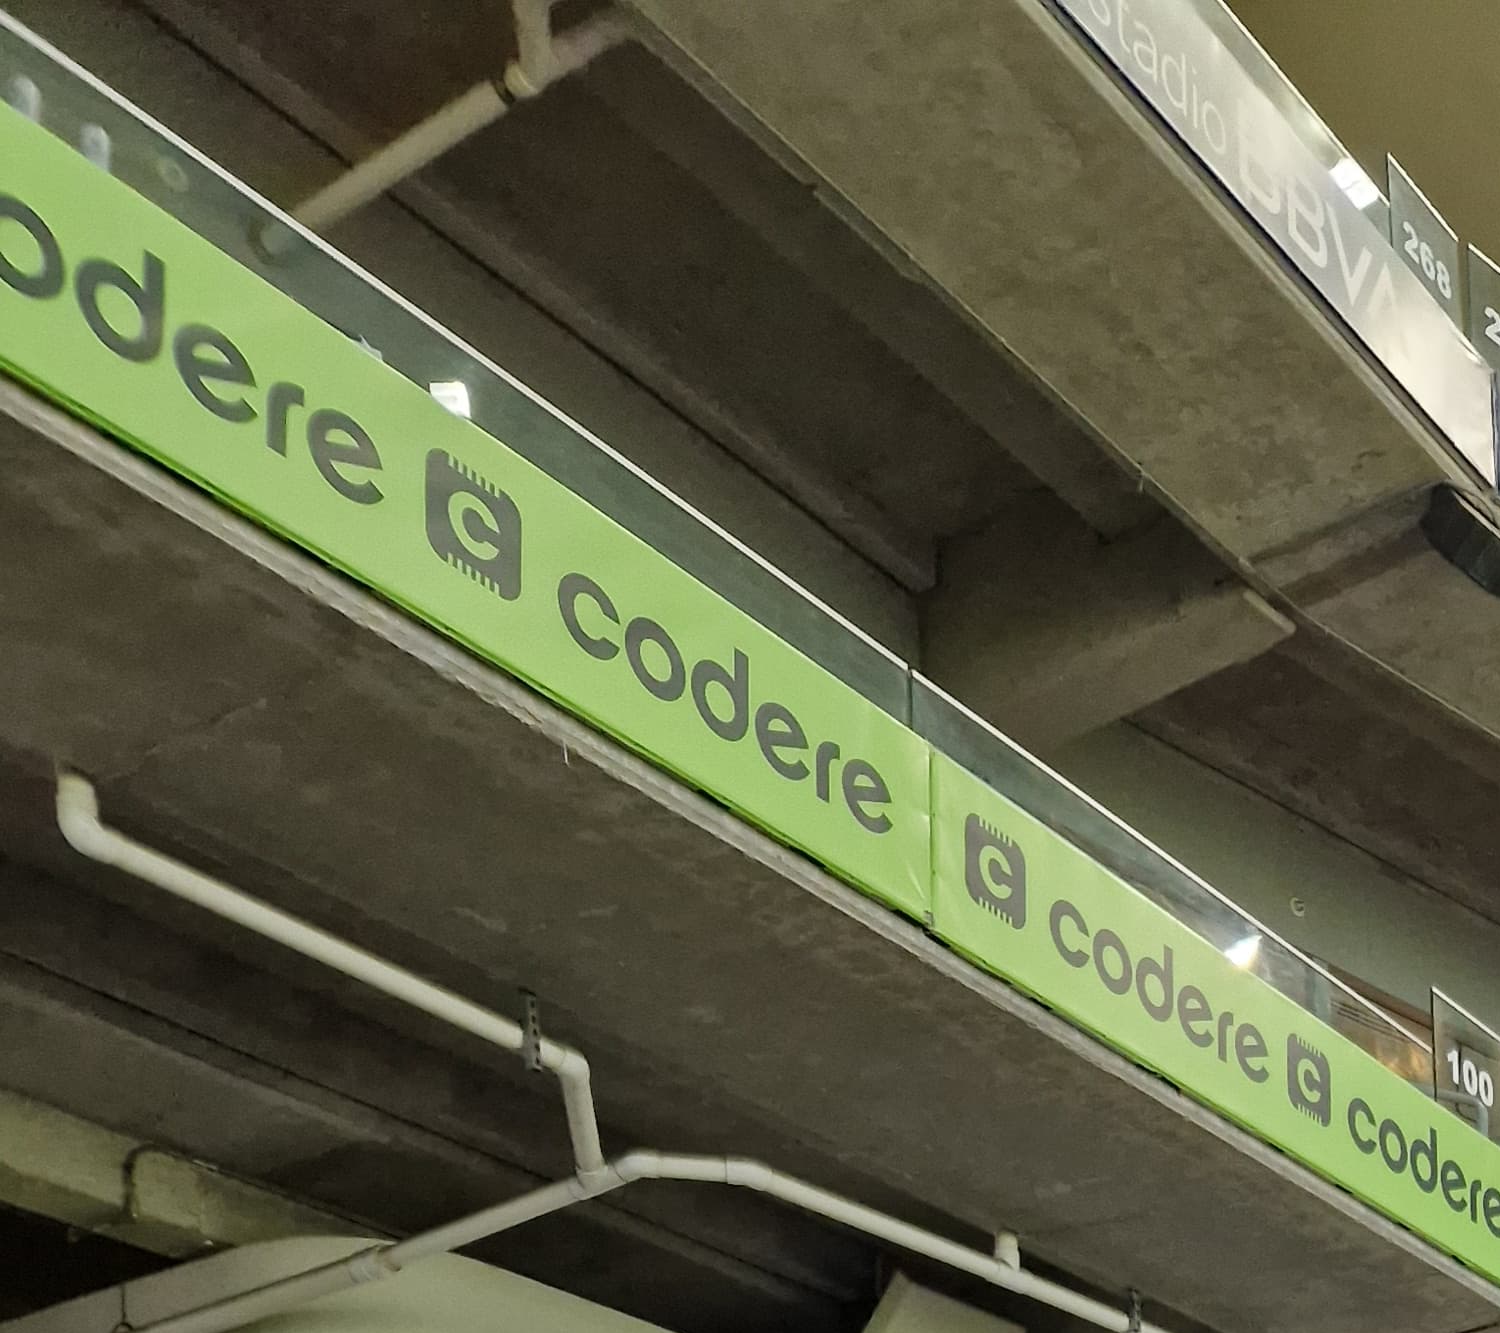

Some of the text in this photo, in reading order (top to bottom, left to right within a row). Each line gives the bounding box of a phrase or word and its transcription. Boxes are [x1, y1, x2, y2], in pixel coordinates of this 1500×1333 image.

[1402, 221, 1452, 300] 268
[557, 570, 894, 836] codere
[1049, 898, 1269, 1084] codere
[1446, 1049, 1495, 1108] 100
